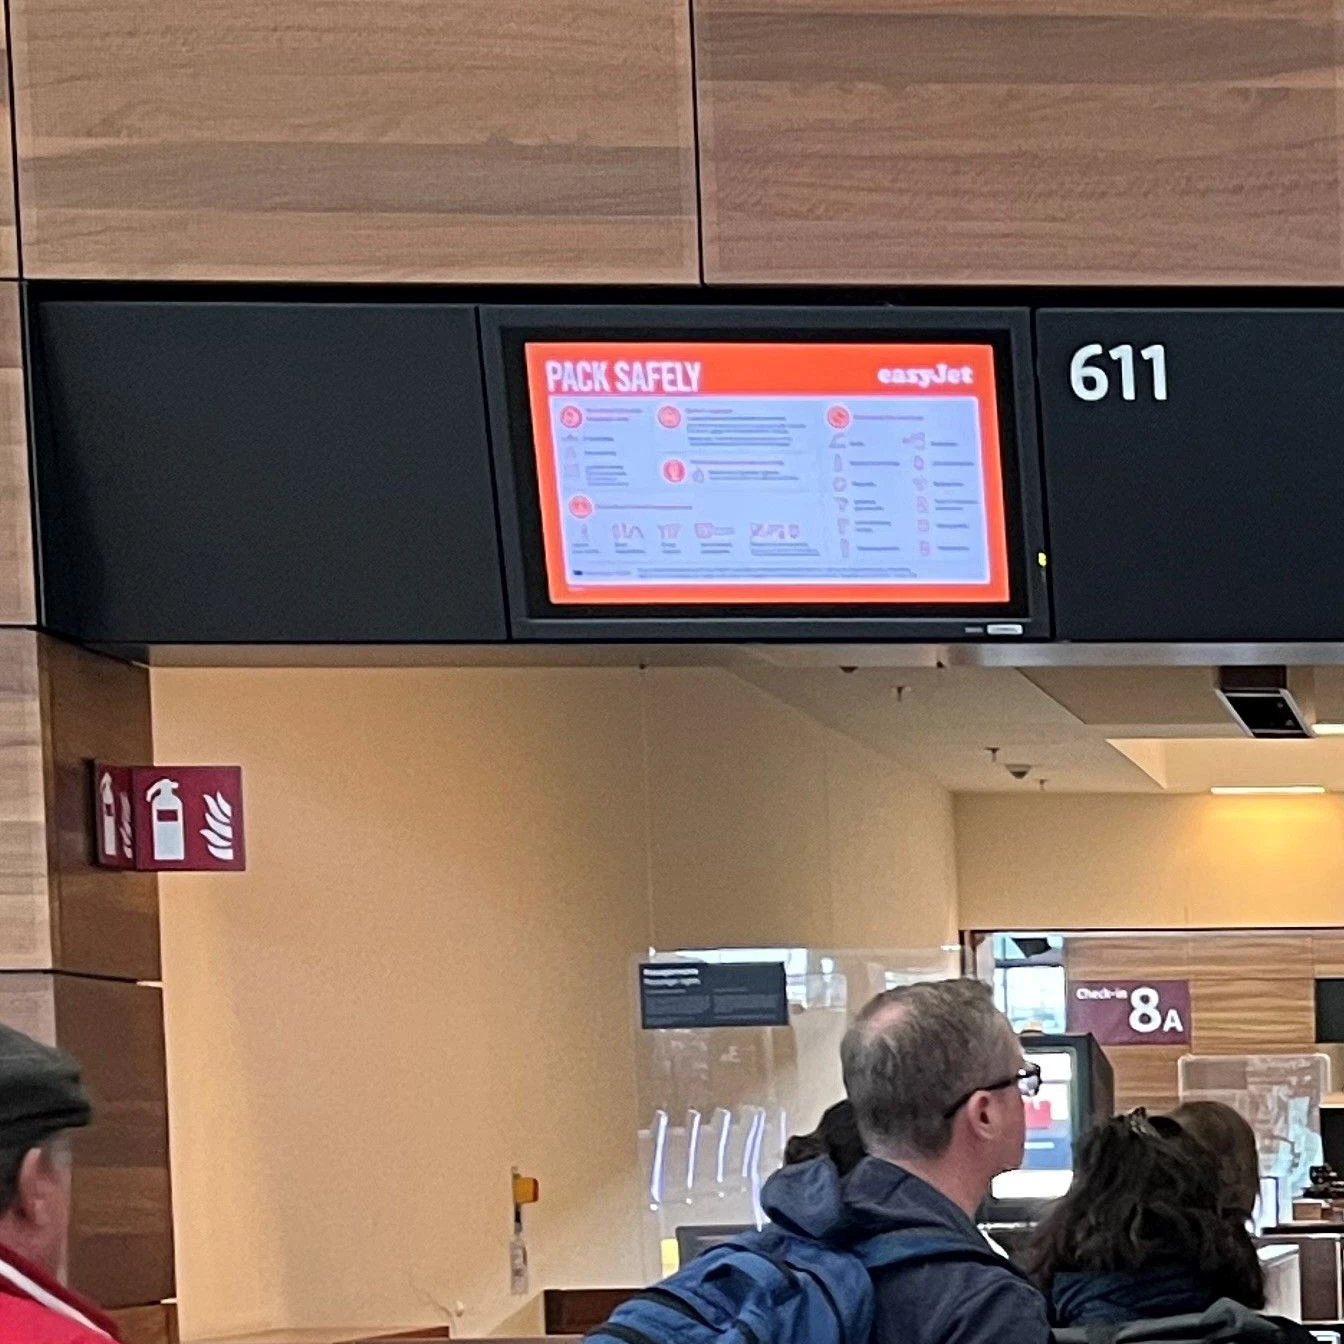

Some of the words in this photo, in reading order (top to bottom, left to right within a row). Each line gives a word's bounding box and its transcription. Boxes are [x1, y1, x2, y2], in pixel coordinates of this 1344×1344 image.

[545, 360, 610, 393] PACK
[614, 360, 701, 393] SAFELY
[877, 363, 974, 389] easyJet
[1070, 343, 1167, 401] 611
[1129, 987, 1184, 1033] 8A
